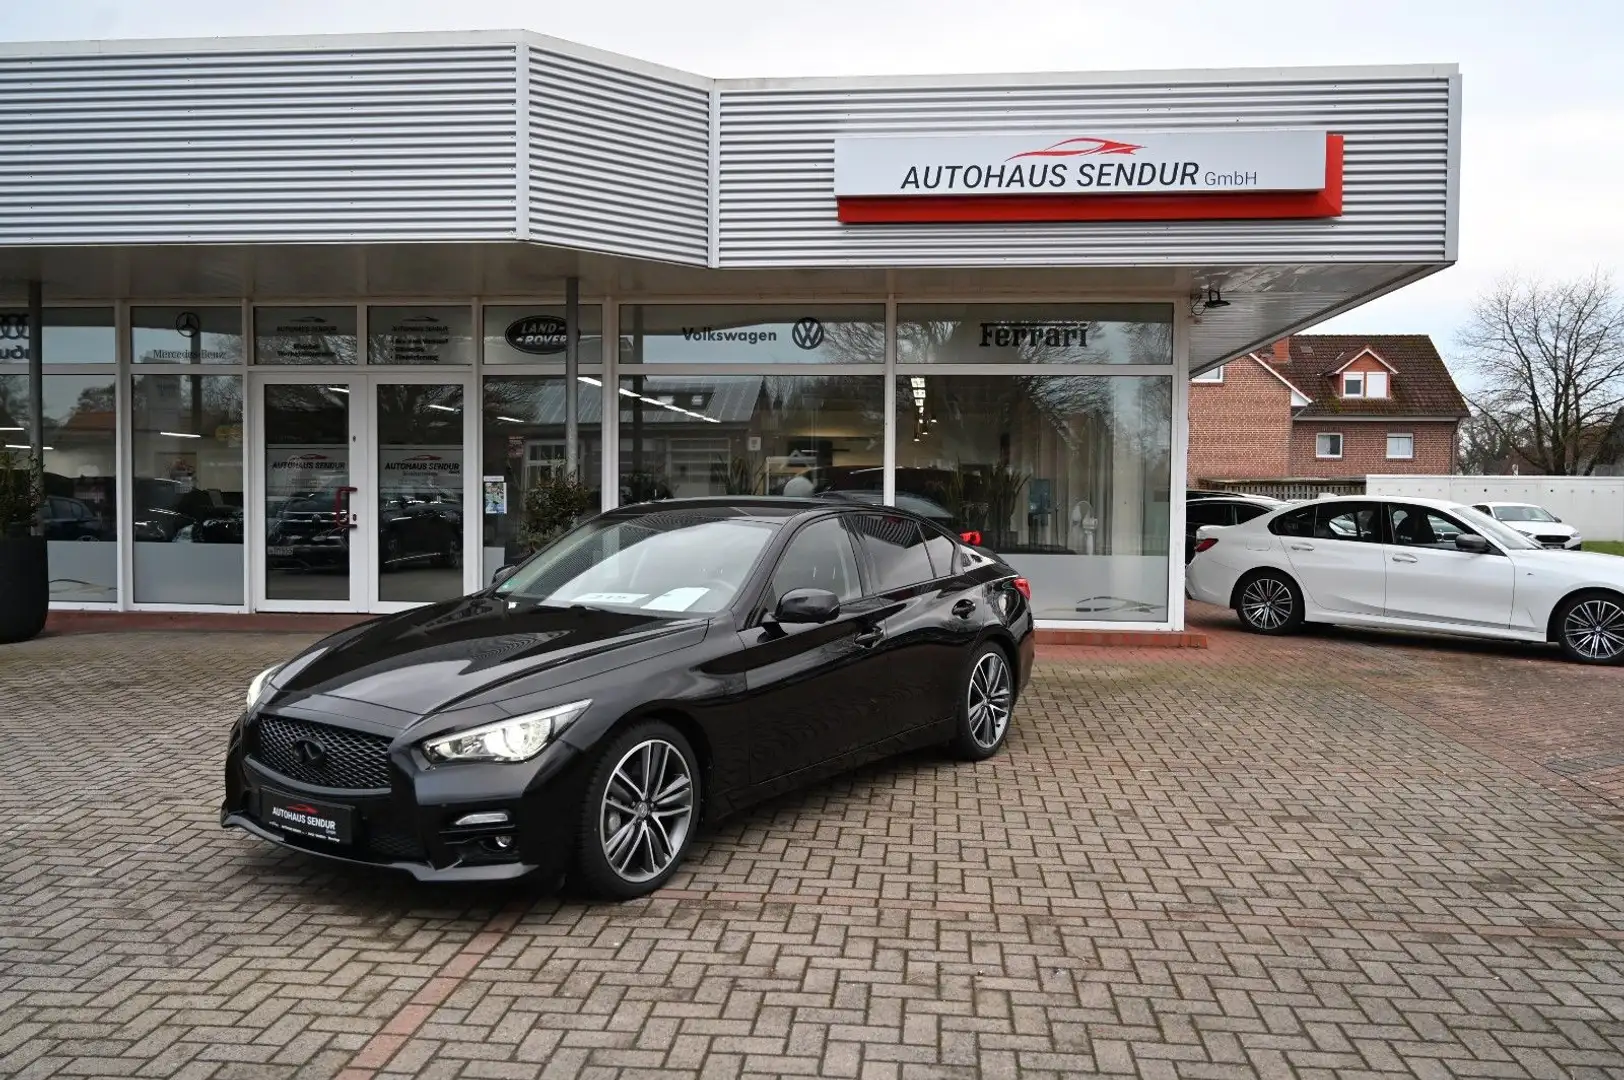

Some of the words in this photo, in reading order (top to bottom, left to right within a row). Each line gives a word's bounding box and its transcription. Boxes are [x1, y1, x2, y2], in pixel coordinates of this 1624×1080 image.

[901, 163, 1068, 189] AUTOHAUS
[1076, 161, 1200, 187] SENDUR
[1203, 171, 1257, 187] GmbH
[682, 327, 777, 344] Volkswagen
[979, 322, 1087, 347] Ferrari
[153, 349, 226, 359] Mercedes-Benz
[385, 462, 427, 470] AUTOHAUS
[272, 806, 306, 824] AUTOHAUS
[306, 816, 336, 830] SENDUR
